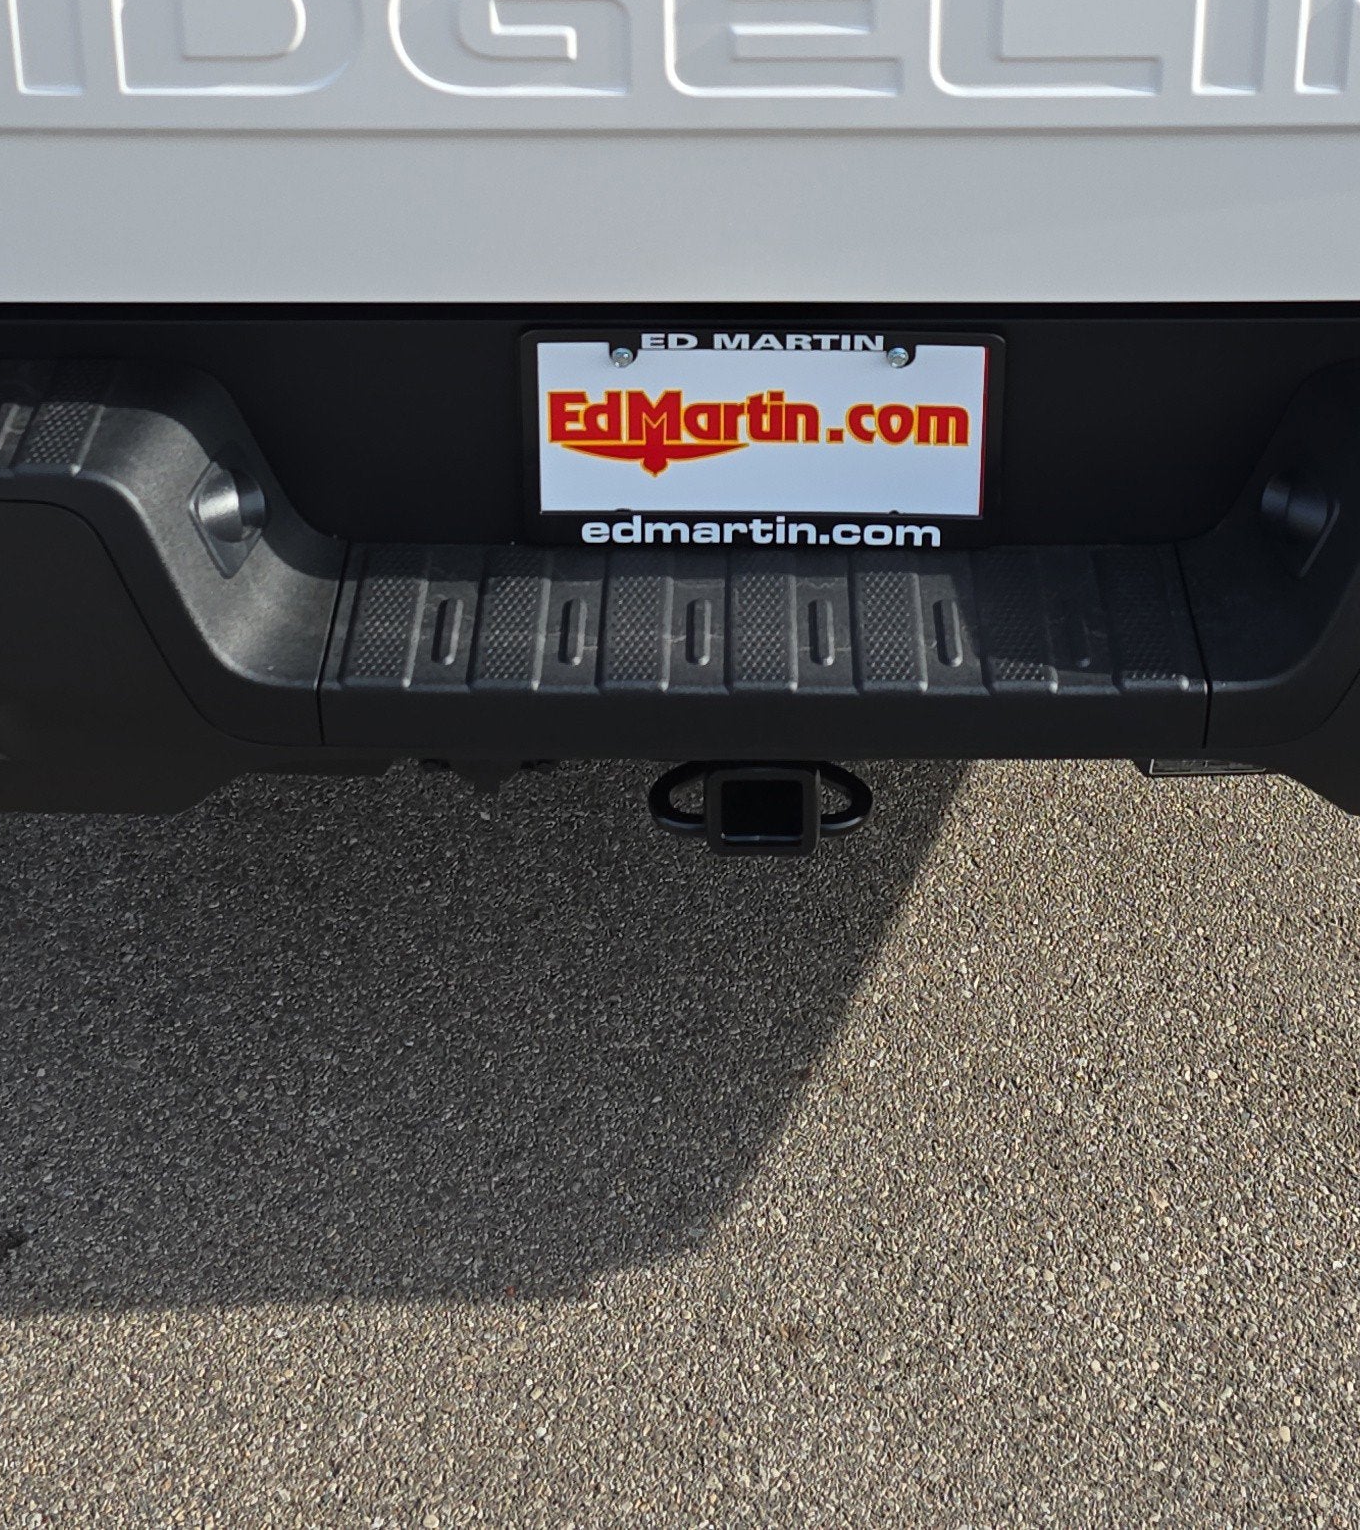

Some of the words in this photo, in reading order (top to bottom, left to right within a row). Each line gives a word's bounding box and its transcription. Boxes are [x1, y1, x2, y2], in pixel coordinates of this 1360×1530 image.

[639, 332, 699, 351] ED
[713, 333, 886, 353] MARTIN
[546, 389, 971, 448] EdMartin.com
[580, 514, 942, 548] edmartin.com
